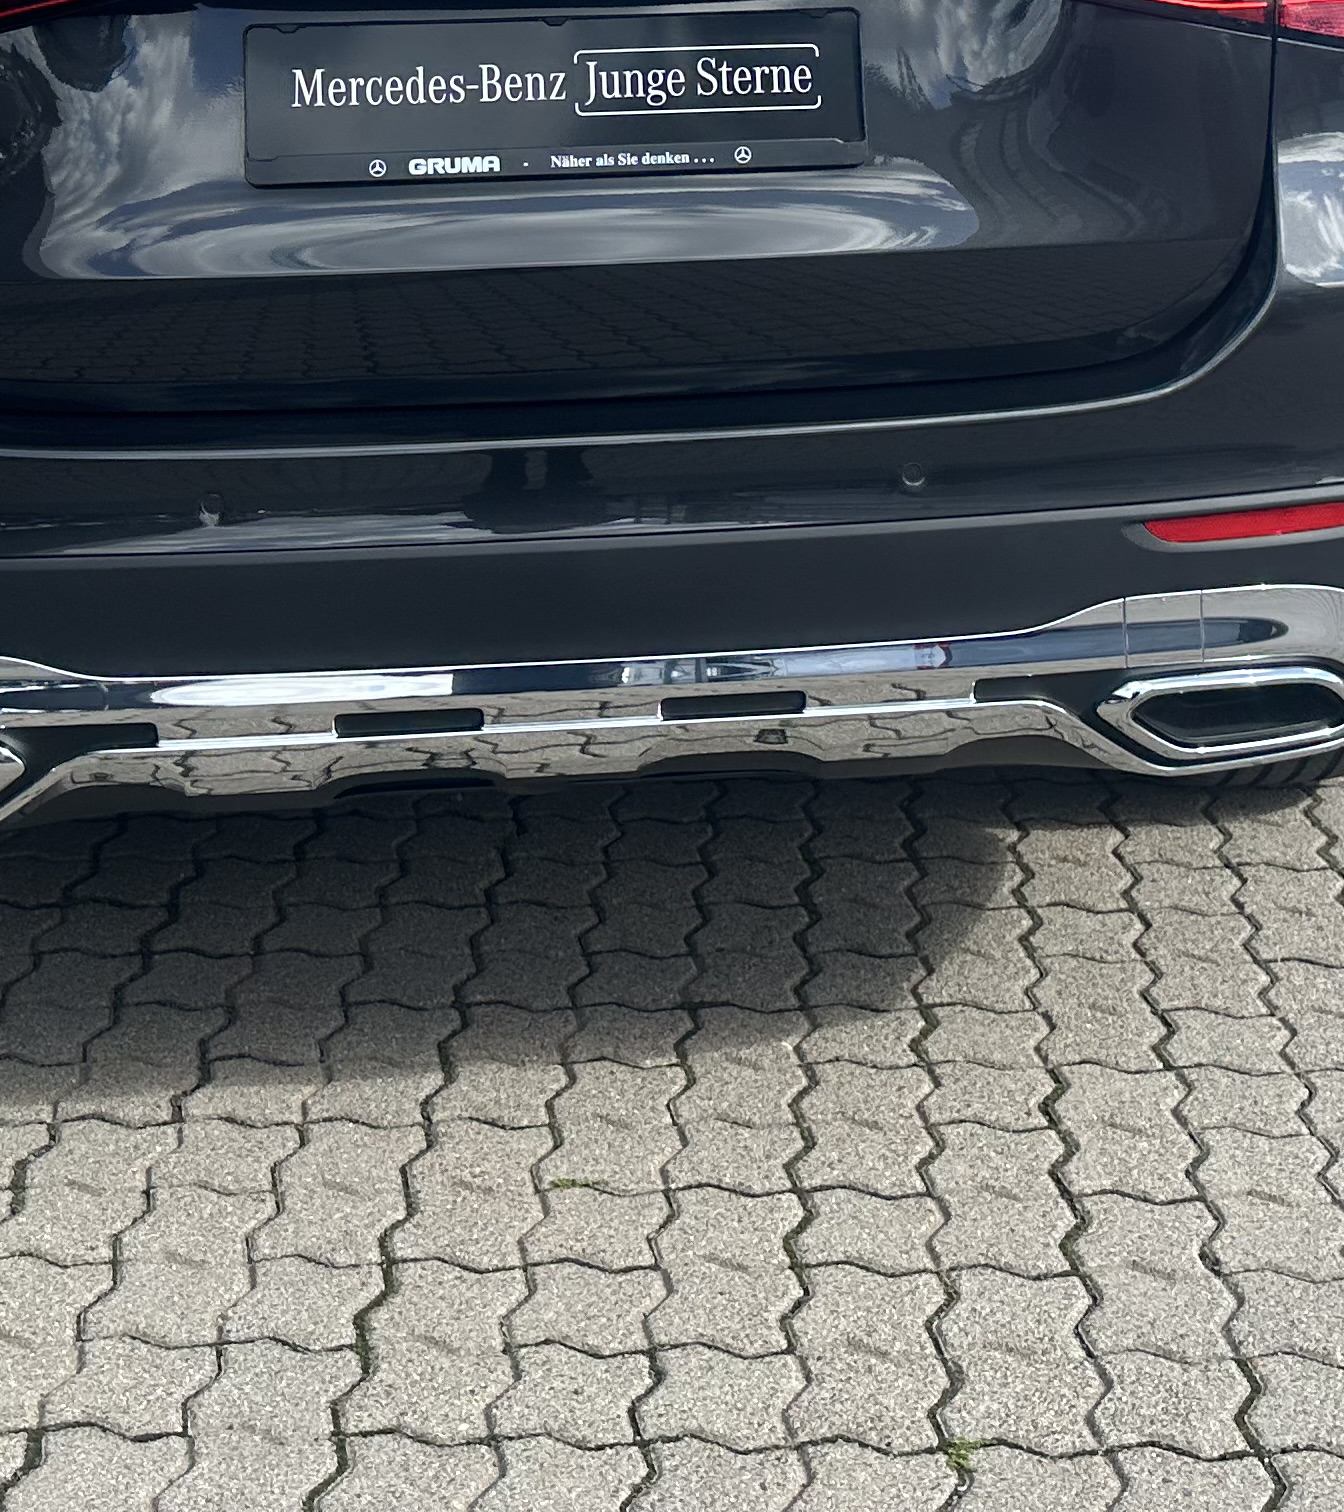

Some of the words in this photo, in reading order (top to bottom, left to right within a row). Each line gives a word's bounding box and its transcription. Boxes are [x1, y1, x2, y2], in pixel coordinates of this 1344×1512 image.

[291, 63, 568, 108] Mercedes-Benz
[584, 59, 686, 106] Junge
[696, 56, 813, 96] Sterne
[408, 155, 501, 176] GRUMA
[550, 154, 592, 168] Näher
[595, 153, 615, 167] als
[617, 152, 639, 167] Sie
